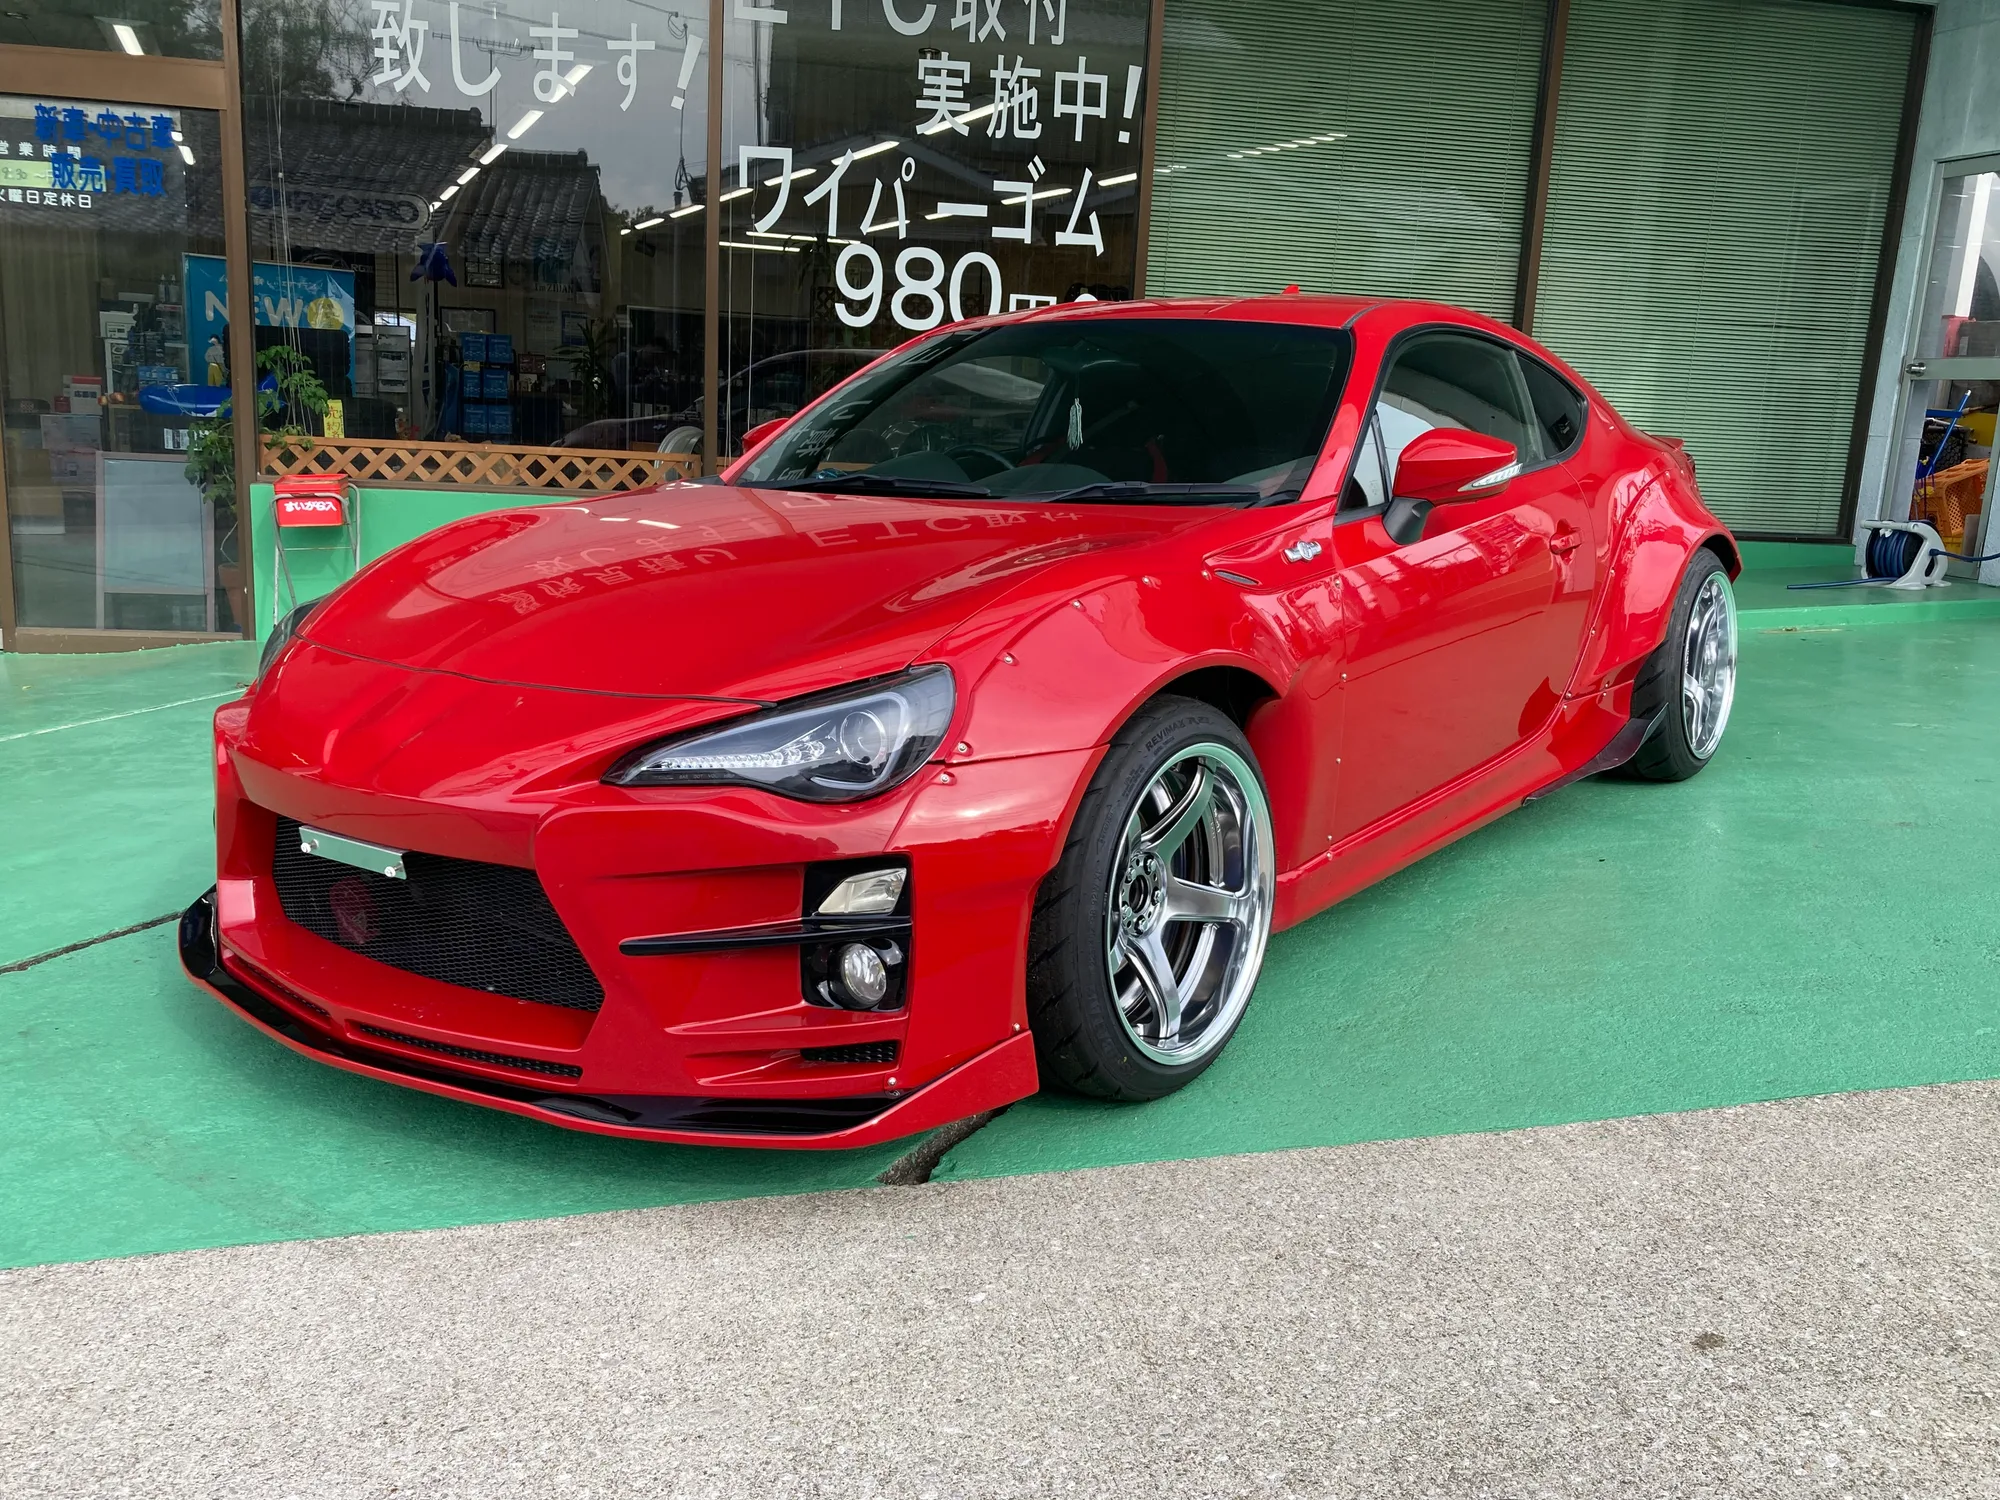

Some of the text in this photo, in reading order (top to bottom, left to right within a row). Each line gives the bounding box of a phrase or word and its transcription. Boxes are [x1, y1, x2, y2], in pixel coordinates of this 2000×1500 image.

[915, 51, 1143, 144] 実施中!
[738, 145, 1105, 257] ワイパーゴム
[205, 290, 304, 328] NW
